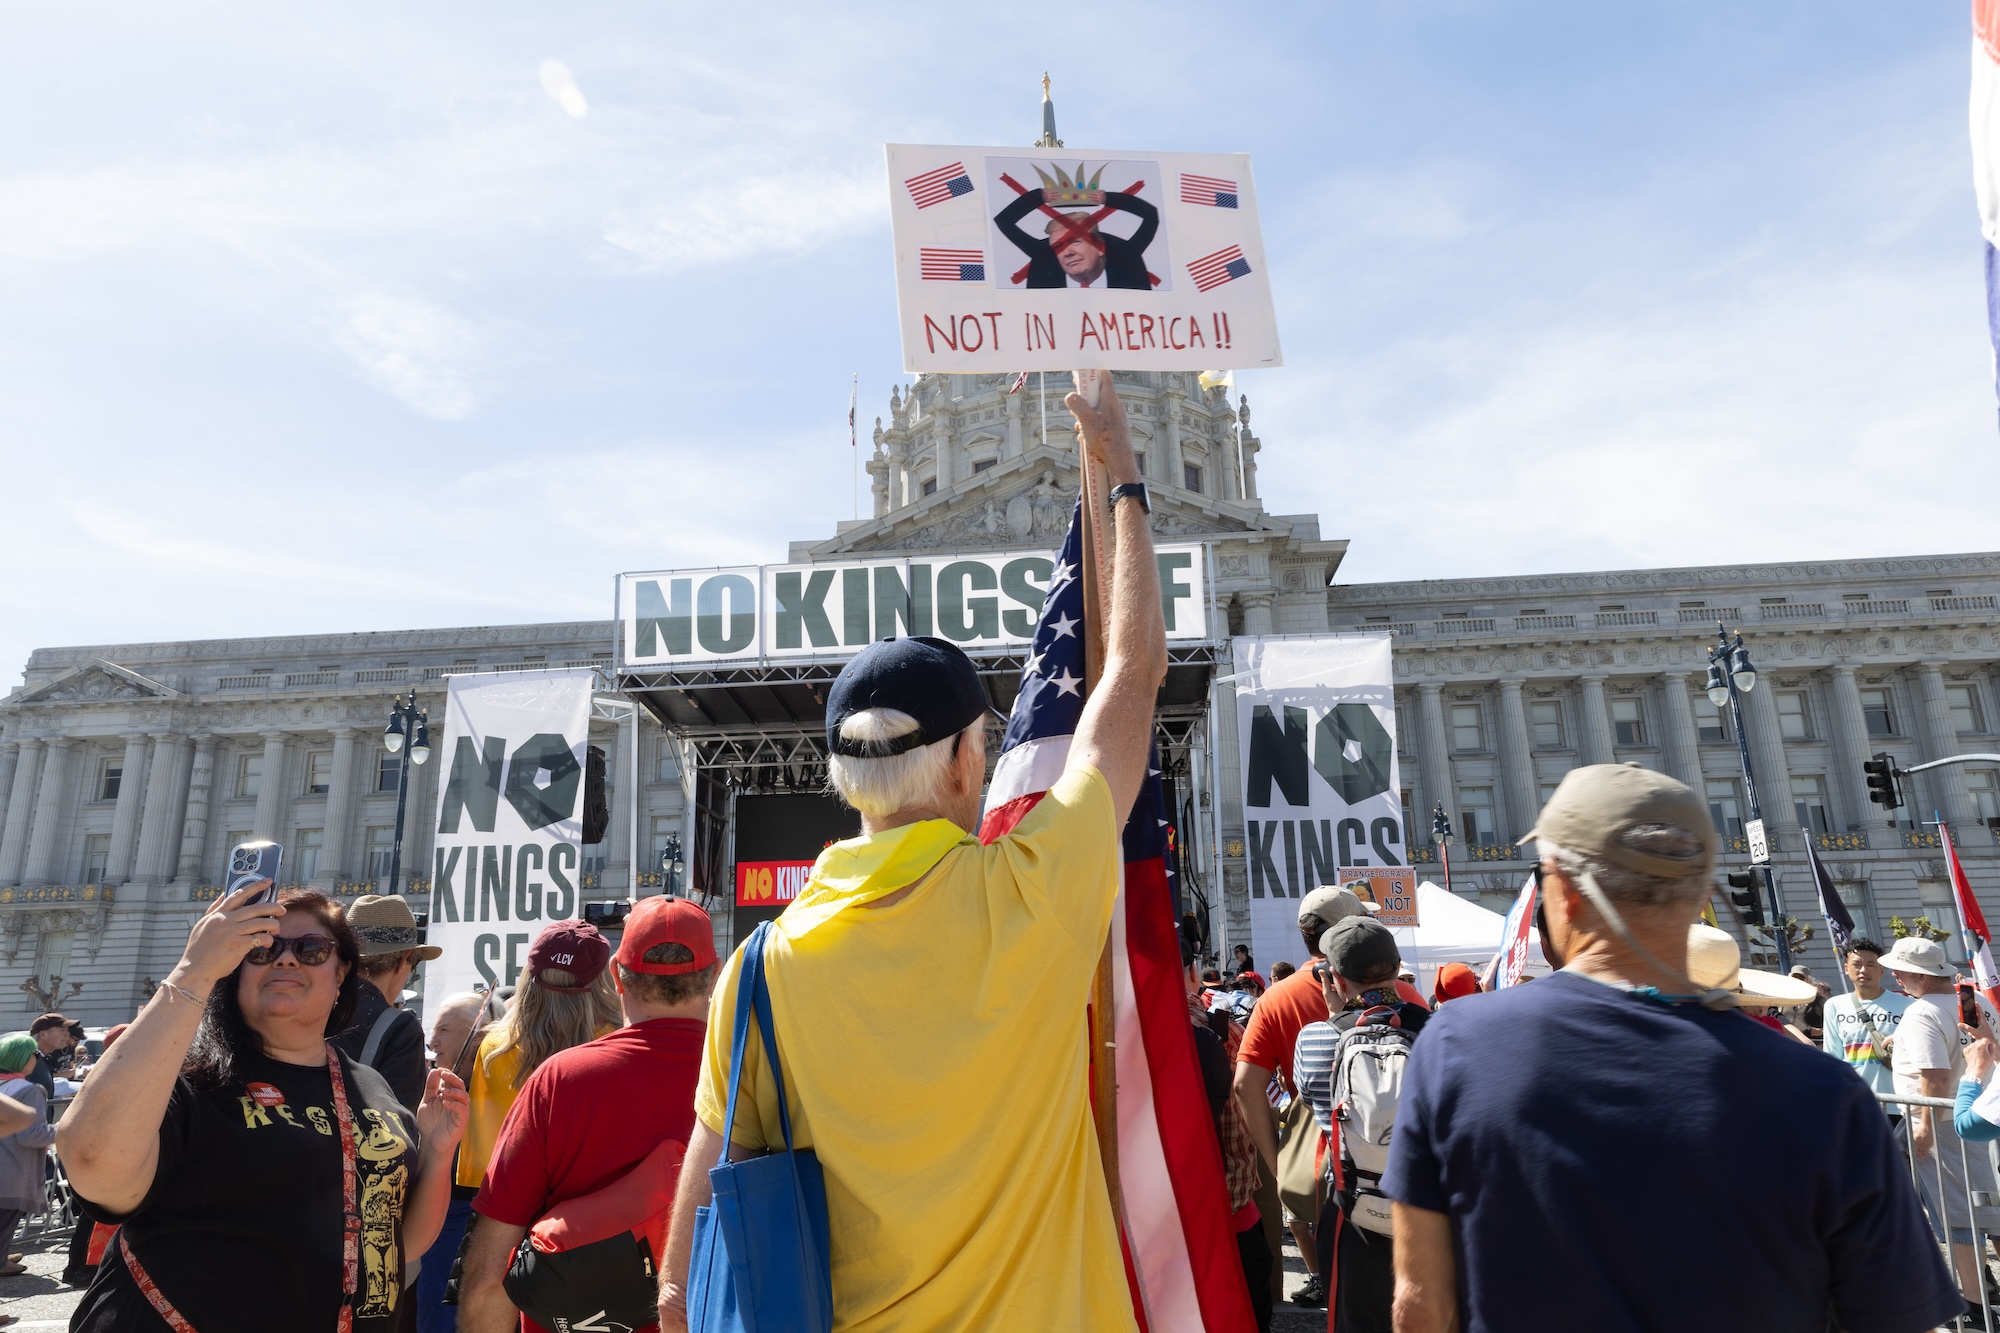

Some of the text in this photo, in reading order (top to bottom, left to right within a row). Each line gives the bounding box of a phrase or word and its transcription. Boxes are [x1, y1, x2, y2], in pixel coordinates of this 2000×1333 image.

[923, 311, 1003, 354] NOT
[1025, 312, 1056, 352] IN
[635, 552, 1192, 658] NO KINGS F
[1247, 703, 1392, 807] NO
[438, 733, 581, 834] NO
[1248, 817, 1402, 899] KINGS
[1752, 842, 1765, 858] 20
[432, 843, 577, 923] KINGS
[743, 867, 773, 900] NO
[777, 866, 815, 900] KIN
[1342, 870, 1412, 879] ORANGE-OCRACY
[1391, 881, 1403, 895] IS
[1374, 915, 1417, 925] MOCRACY!
[1384, 897, 1411, 911] NOT
[556, 952, 574, 966] LCV
[237, 1096, 412, 1140] RESST
